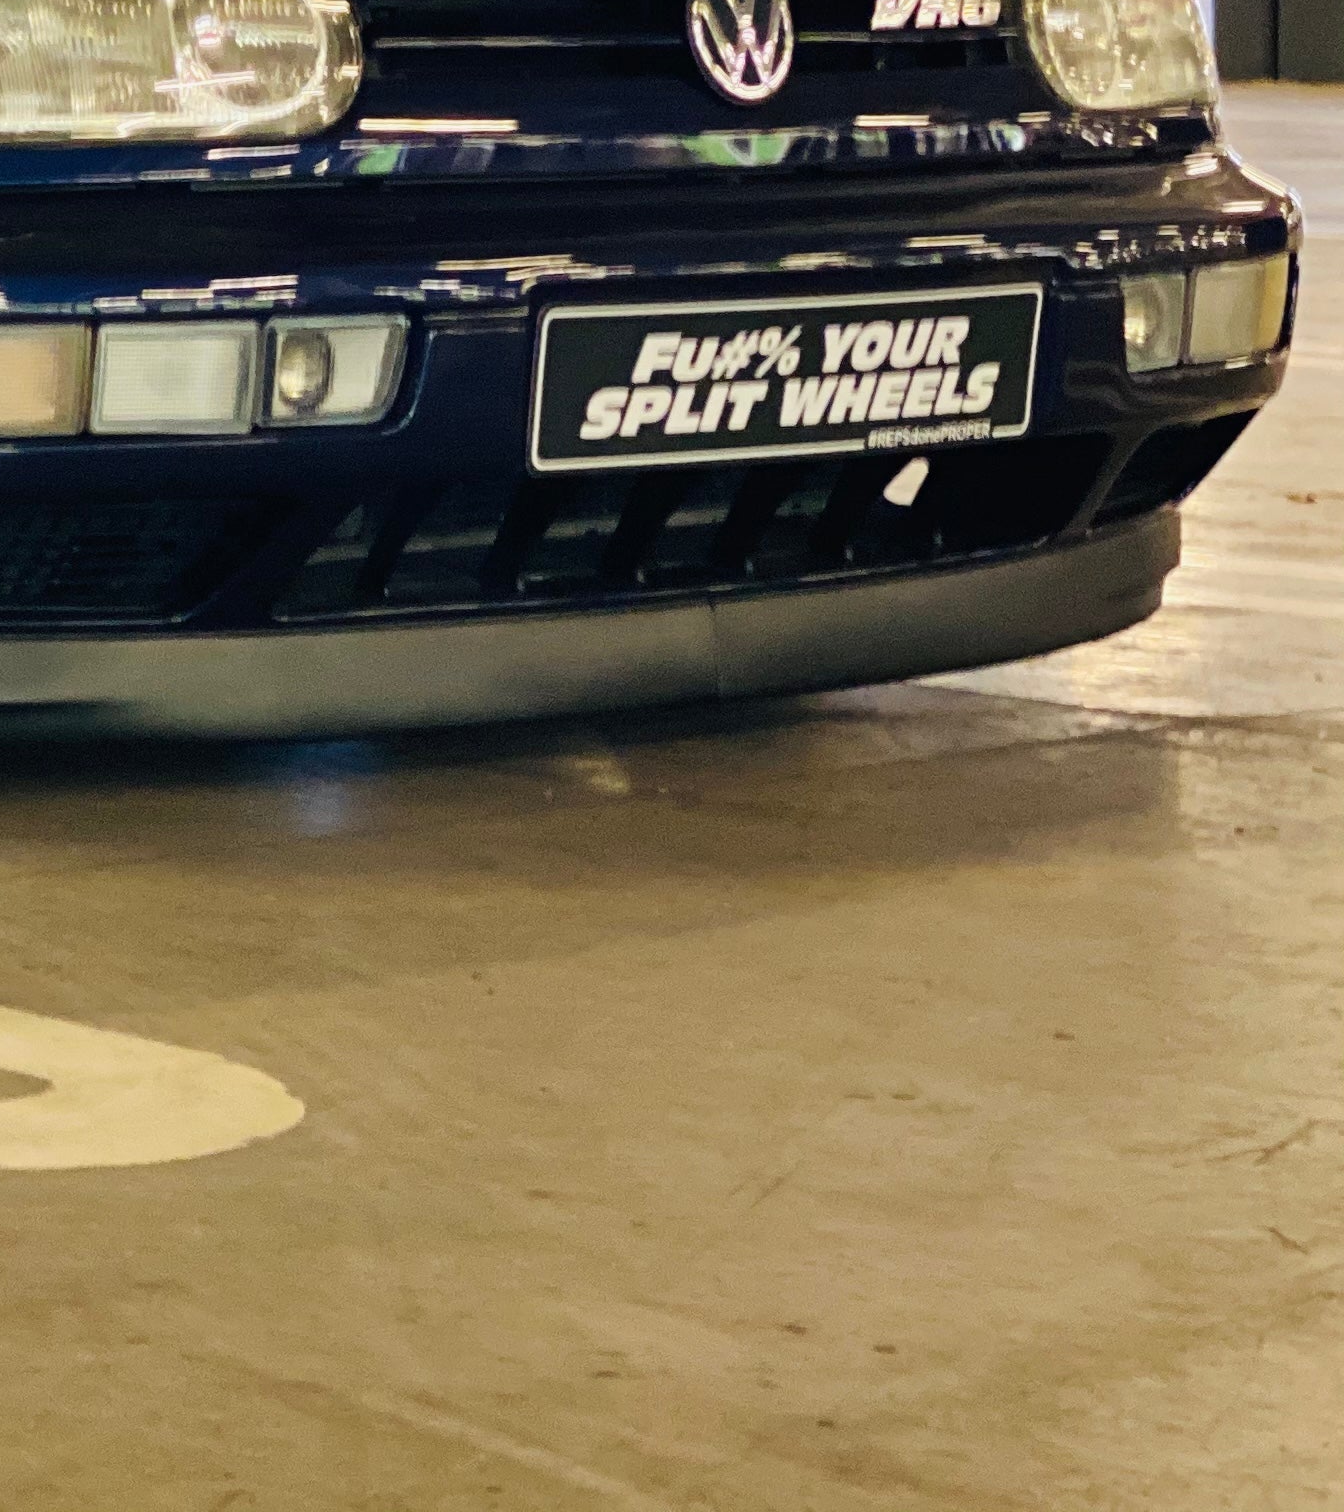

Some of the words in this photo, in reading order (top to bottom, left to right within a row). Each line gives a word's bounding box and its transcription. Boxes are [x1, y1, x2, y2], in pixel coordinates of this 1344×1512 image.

[821, 315, 970, 374] YOUR
[579, 379, 768, 440] SPLIT
[779, 361, 1000, 427] WHEELS
